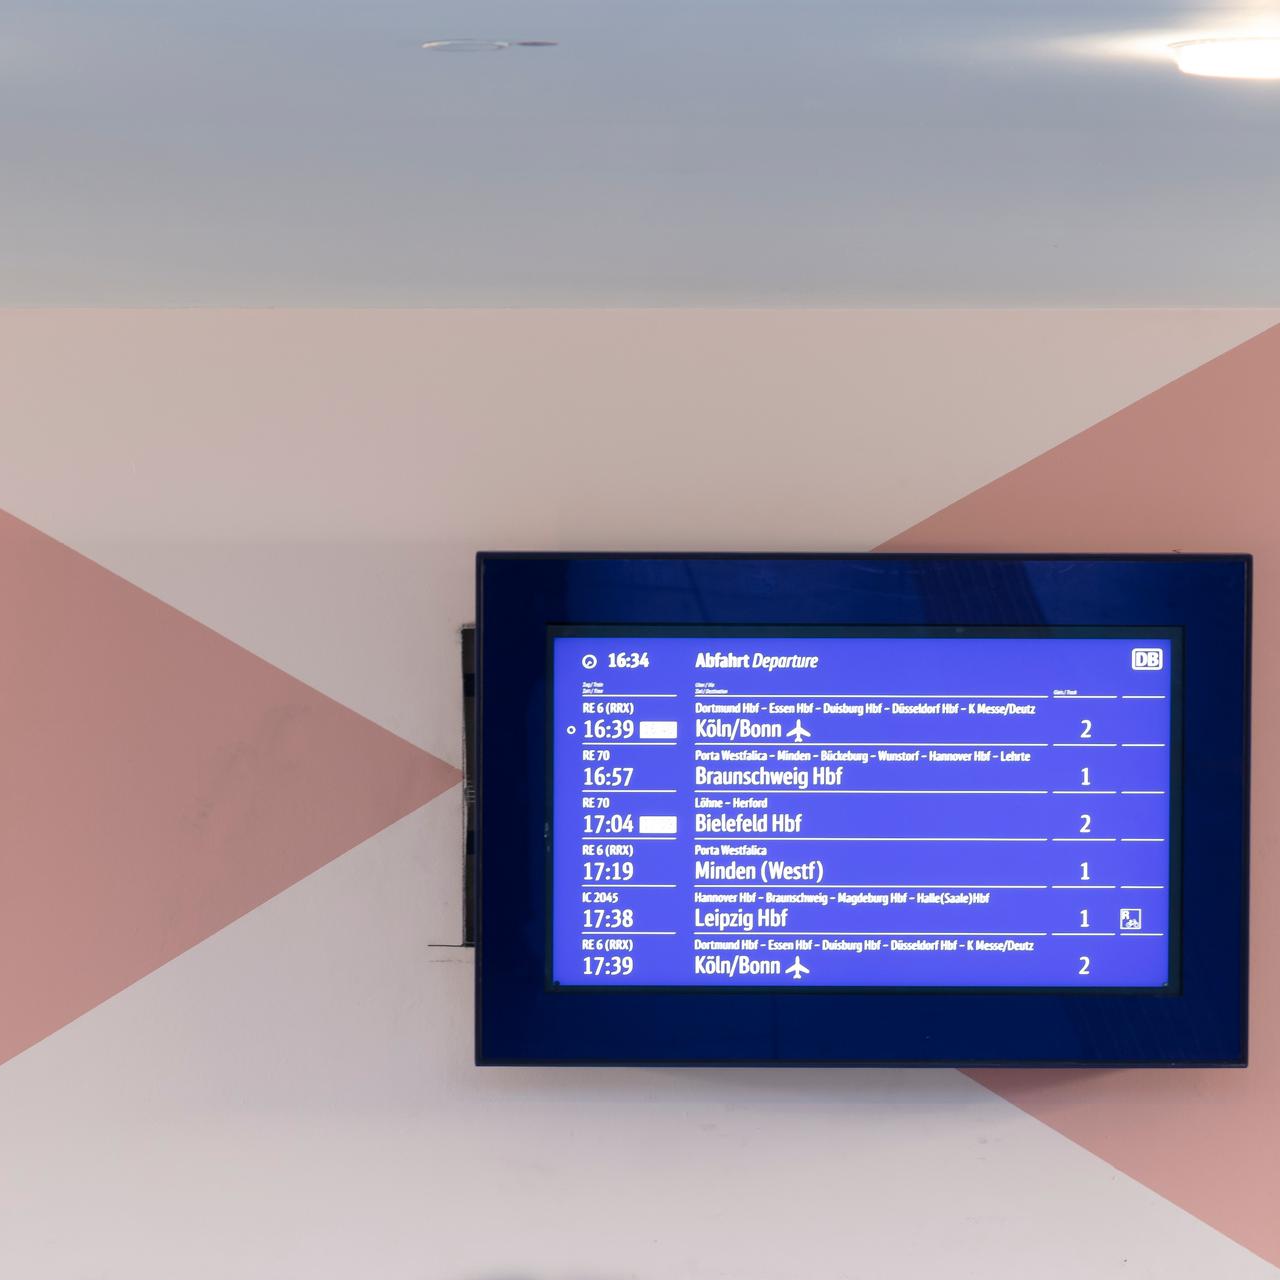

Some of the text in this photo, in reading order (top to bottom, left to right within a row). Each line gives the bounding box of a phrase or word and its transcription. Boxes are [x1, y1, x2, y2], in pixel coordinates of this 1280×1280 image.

[608, 651, 650, 669] 16:34
[694, 651, 819, 672] Abfahrt Departure
[1133, 650, 1161, 669] DB
[582, 702, 635, 716] RE 6 (RRX)
[694, 701, 742, 714] Dortmund
[741, 702, 761, 714] Hbf
[768, 702, 796, 714] Essen
[796, 702, 815, 714] Hbf
[822, 702, 865, 717] Duisburg
[864, 702, 884, 714] Hbf
[891, 702, 942, 715] Düsseldorf
[941, 702, 960, 715] Hbf
[968, 702, 976, 715] K
[976, 702, 1036, 717] Messe/Deutz
[583, 718, 635, 739] 16:39
[695, 718, 782, 741] Köln/Bonn
[1080, 719, 1092, 739] 2
[582, 749, 611, 762] RE 70
[694, 749, 721, 761] Porta
[720, 749, 768, 762] Westfalica
[776, 749, 812, 762] Minden
[820, 749, 869, 764] Bückeburg
[877, 750, 921, 762] Wunstorf
[928, 750, 973, 762] Hannover
[973, 750, 992, 762] Hbf
[1000, 750, 1032, 762] Lehrte
[583, 766, 634, 787] 16:57
[695, 765, 844, 789] Braunschweig Hbf
[1081, 767, 1091, 786] 1
[582, 796, 610, 809] RE 70
[694, 796, 724, 809] Löhne
[732, 796, 769, 809] Herford
[583, 813, 635, 834] 17:04
[695, 813, 803, 833] Bielefeld Hbf
[1079, 814, 1091, 833] 2
[582, 844, 634, 858] RE 6 (RRX)
[694, 844, 768, 856] Porta Westfalica
[583, 861, 634, 881] 17:19
[695, 860, 824, 884] Minden (Westf)
[1080, 861, 1090, 881] 1
[581, 891, 619, 904] IC 2045
[694, 891, 739, 904] Hannover
[738, 891, 757, 904] Hbf
[765, 891, 829, 906] Braunschweig
[837, 891, 890, 906] Magdeburg
[889, 891, 909, 904] Hbf
[916, 892, 991, 906] Halle(Saale)Hbf
[583, 908, 634, 929] 17:38
[694, 907, 789, 932] Leipzig Hbf
[1079, 909, 1090, 928] 1
[581, 938, 634, 952] RE 6 (RRX)
[693, 938, 741, 951] Dortmund
[740, 938, 760, 951] Hbf
[767, 938, 795, 951] Essen
[794, 939, 814, 951] Hbf
[821, 939, 864, 954] Duisburg
[863, 939, 882, 951] Hbf
[890, 939, 940, 951] Düsseldorf
[939, 939, 958, 951] Hbf
[966, 939, 975, 951] K
[975, 939, 1035, 953] Messe/Deutz
[583, 955, 634, 976] 17:39
[694, 954, 781, 978] Köln/Bonn
[1078, 955, 1090, 975] 2
